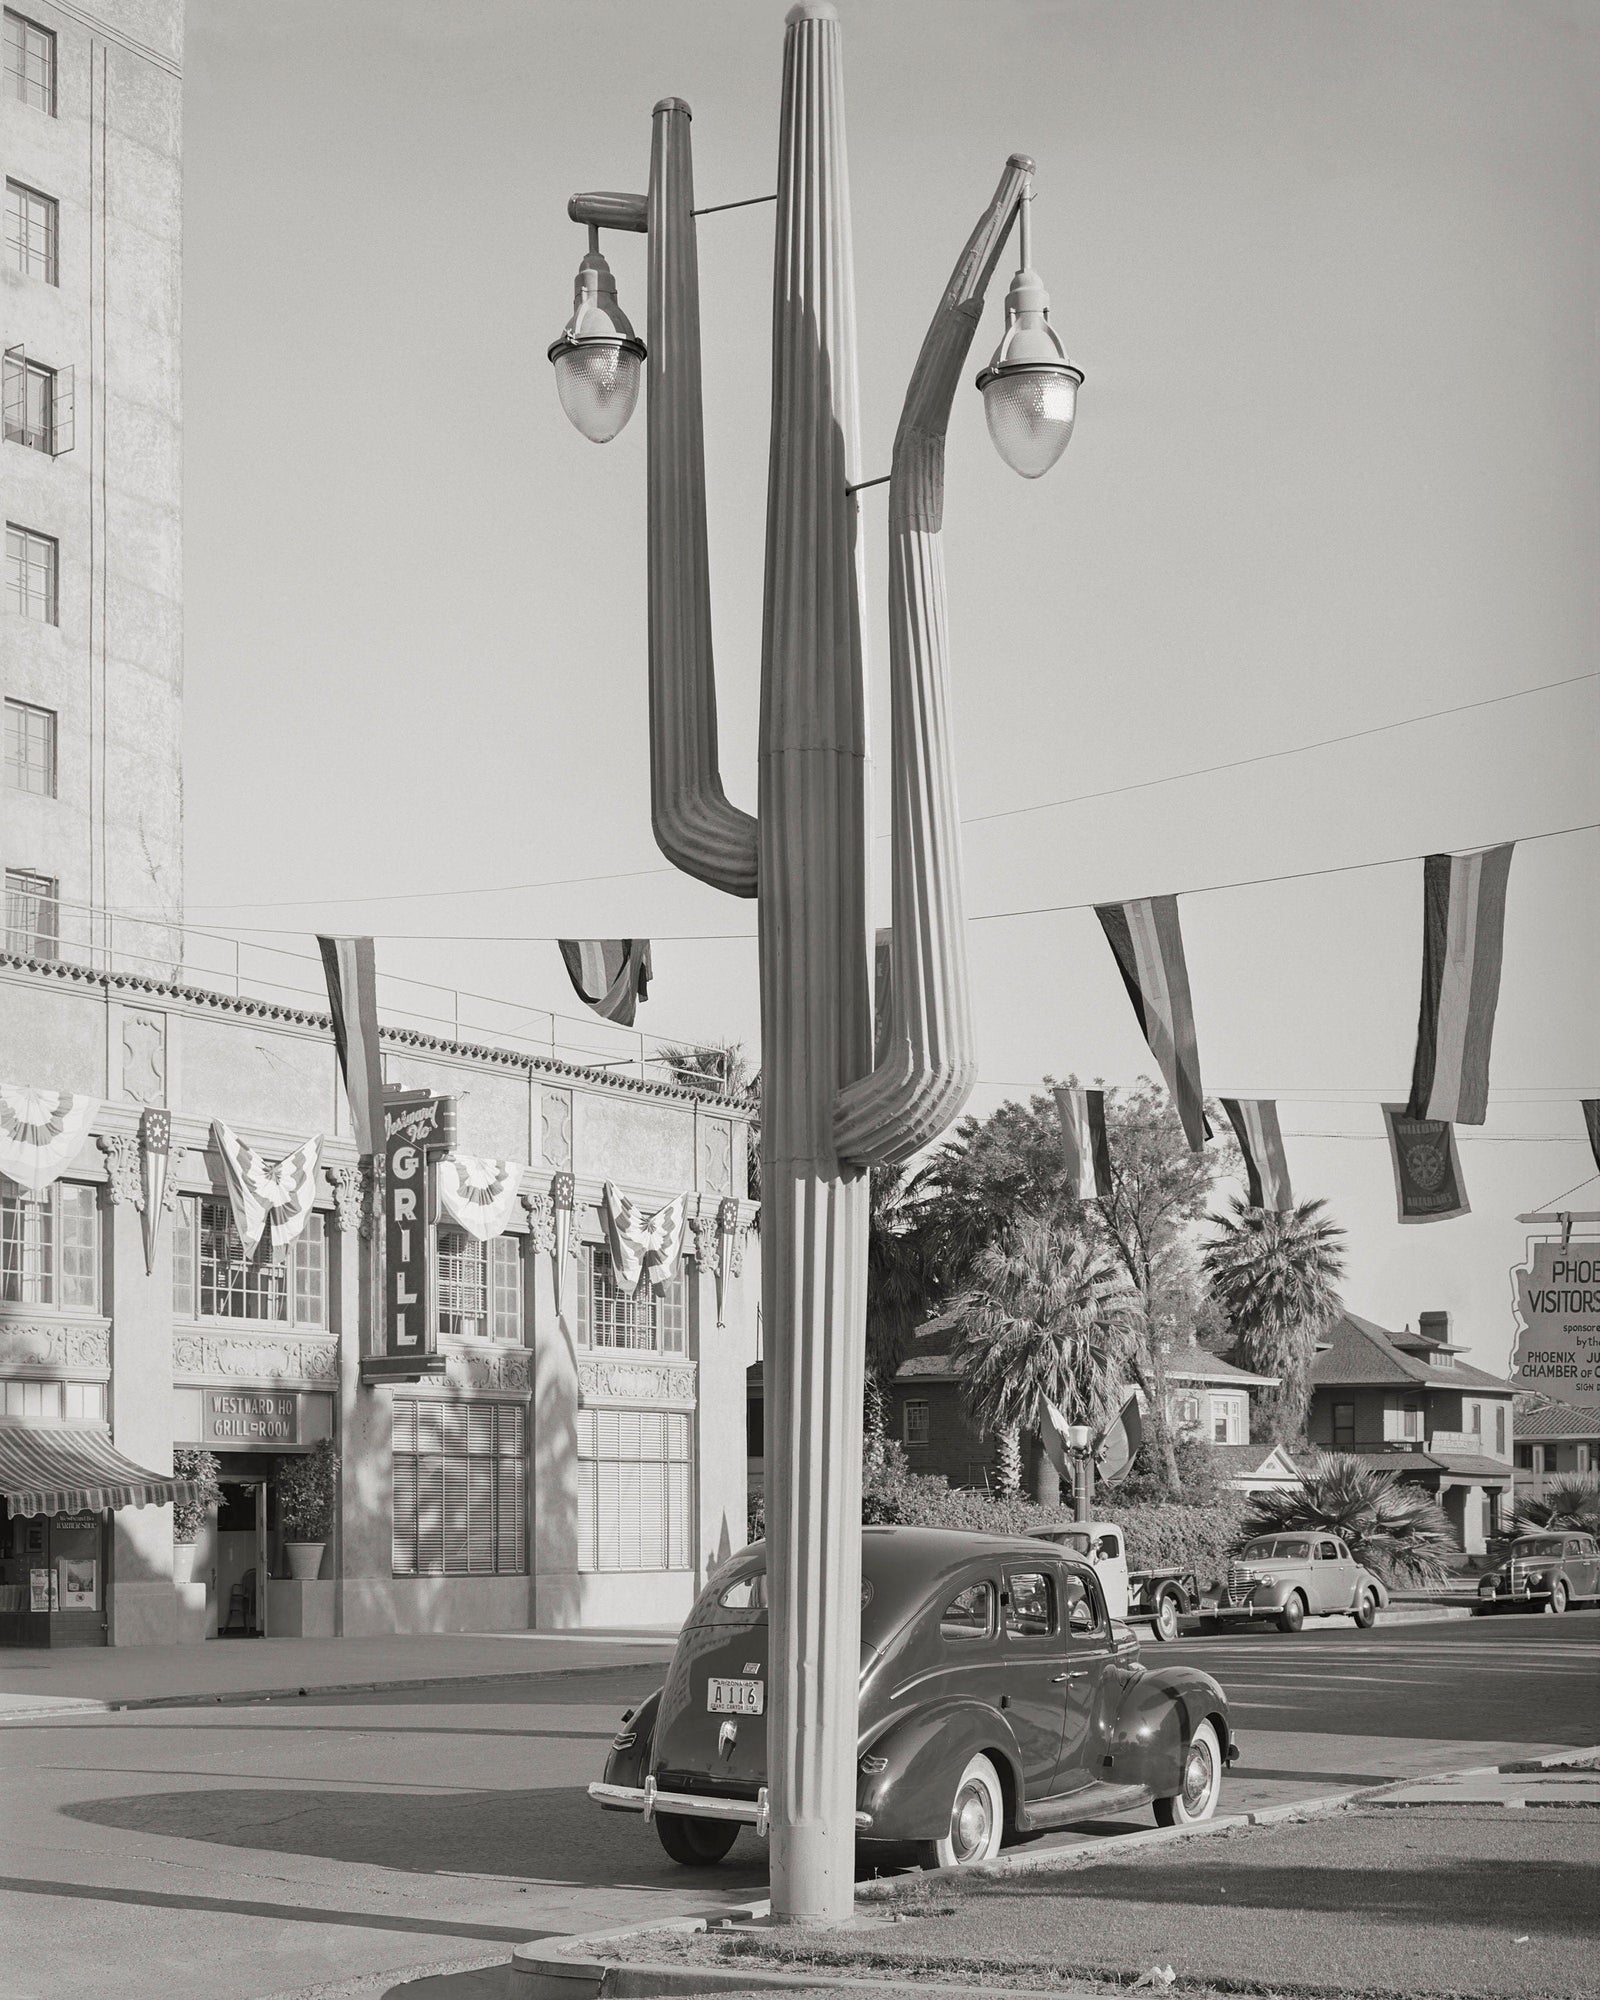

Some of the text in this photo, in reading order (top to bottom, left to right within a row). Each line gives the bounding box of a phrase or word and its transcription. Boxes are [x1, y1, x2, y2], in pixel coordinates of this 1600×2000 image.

[406, 1120, 432, 1142] Ho
[392, 1147, 419, 1346] GRILL
[1553, 1260, 1600, 1283] PHOE
[1528, 1290, 1600, 1313] VISITORS
[1588, 1336, 1600, 1346] th
[1528, 1351, 1600, 1363] PHOENIX JU
[1522, 1364, 1578, 1378] CHAMBER
[1580, 1370, 1592, 1378] OF
[1575, 1383, 1594, 1391] SIGN
[213, 1396, 293, 1416] WESTWARD HO
